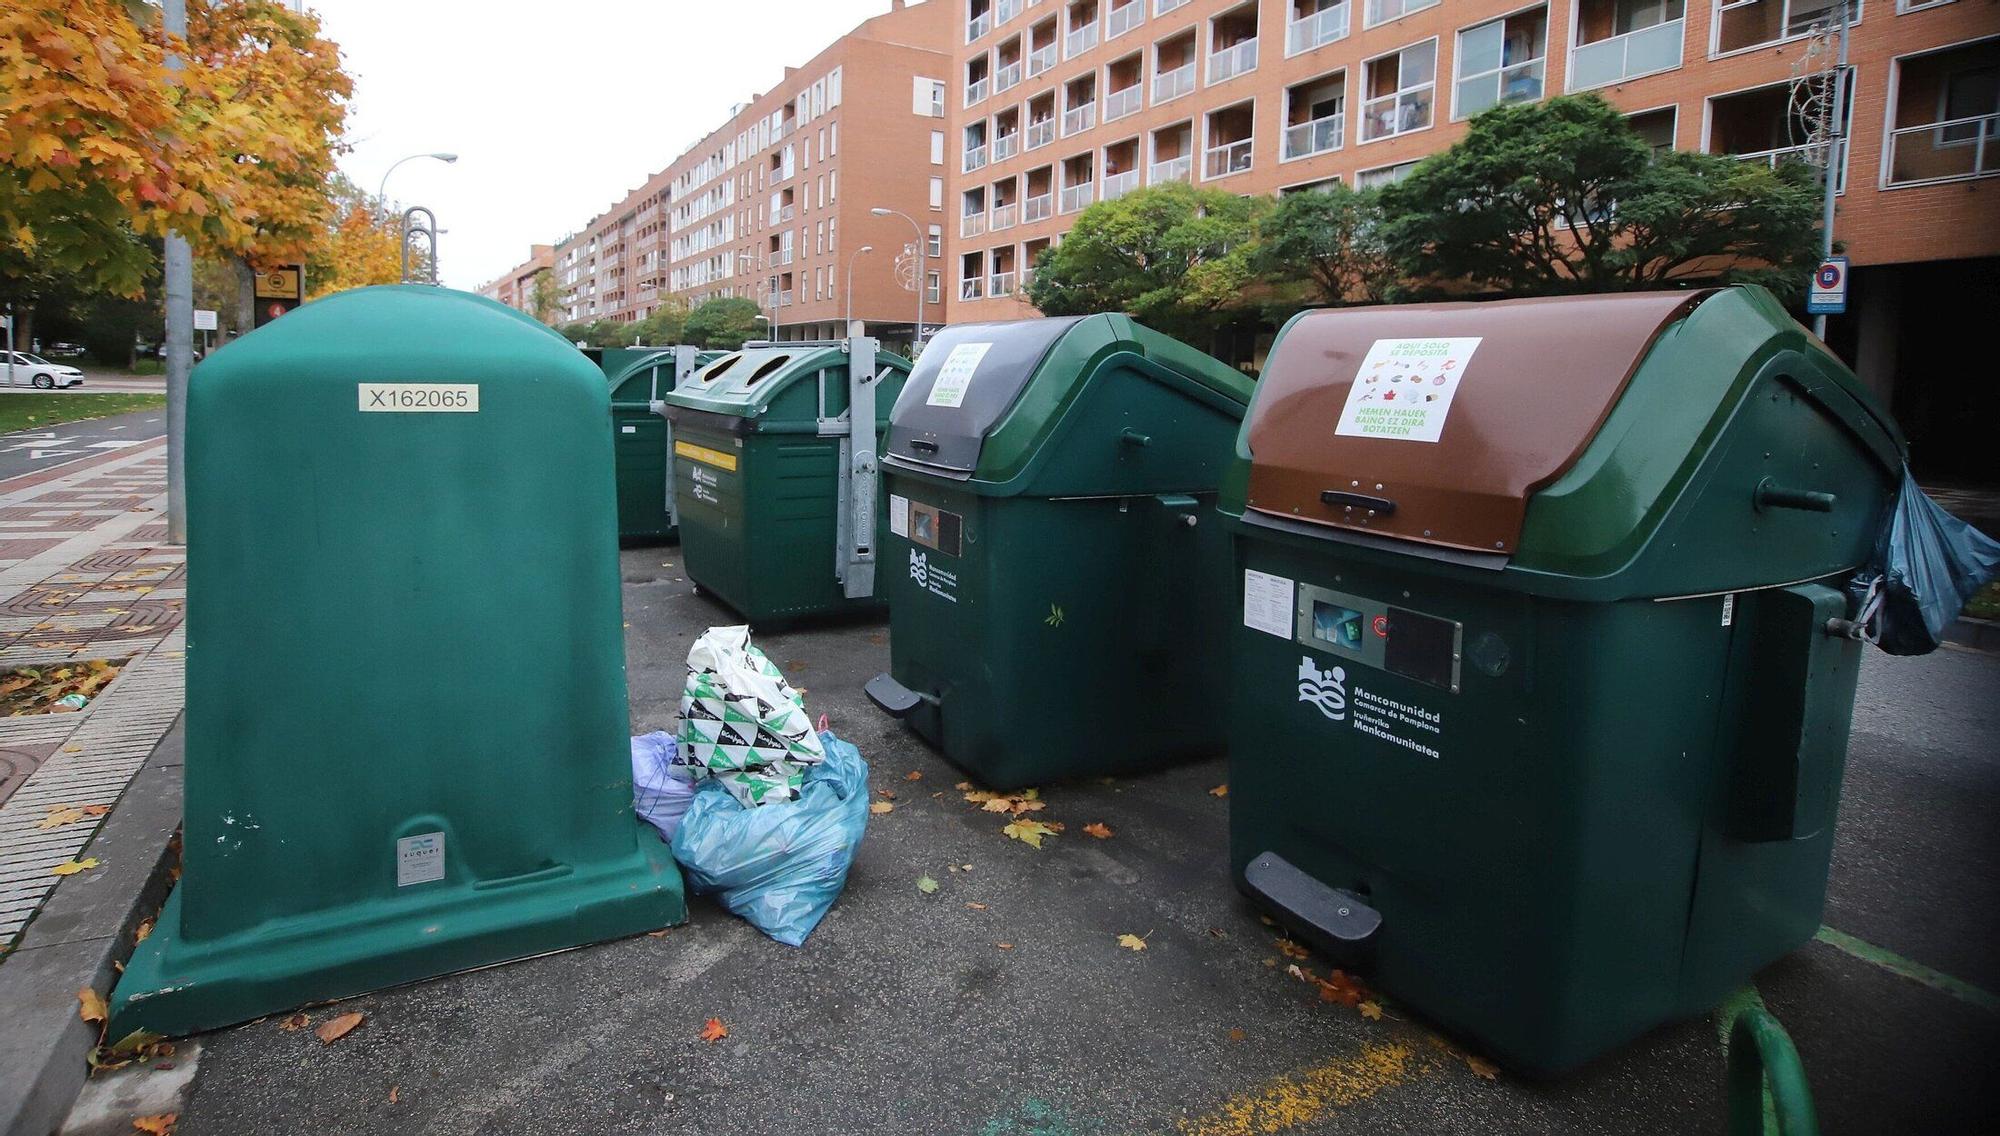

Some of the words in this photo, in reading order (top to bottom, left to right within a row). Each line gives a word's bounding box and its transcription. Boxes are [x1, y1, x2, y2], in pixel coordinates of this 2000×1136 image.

[370, 389, 468, 407] X162065
[1355, 416, 1385, 425] BAINO
[1387, 417, 1399, 425] EZ
[1401, 418, 1425, 427] DIRA
[1359, 407, 1391, 417] HEMEN
[1393, 408, 1427, 418] HAUEK
[1362, 425, 1410, 435] BOTATZEN
[1354, 687, 1440, 723] Mancomunidad
[1354, 698, 1386, 715] Comarca
[1387, 710, 1398, 719] de
[1399, 713, 1440, 734] Pamplona
[1353, 719, 1439, 759] Mankomunitatea
